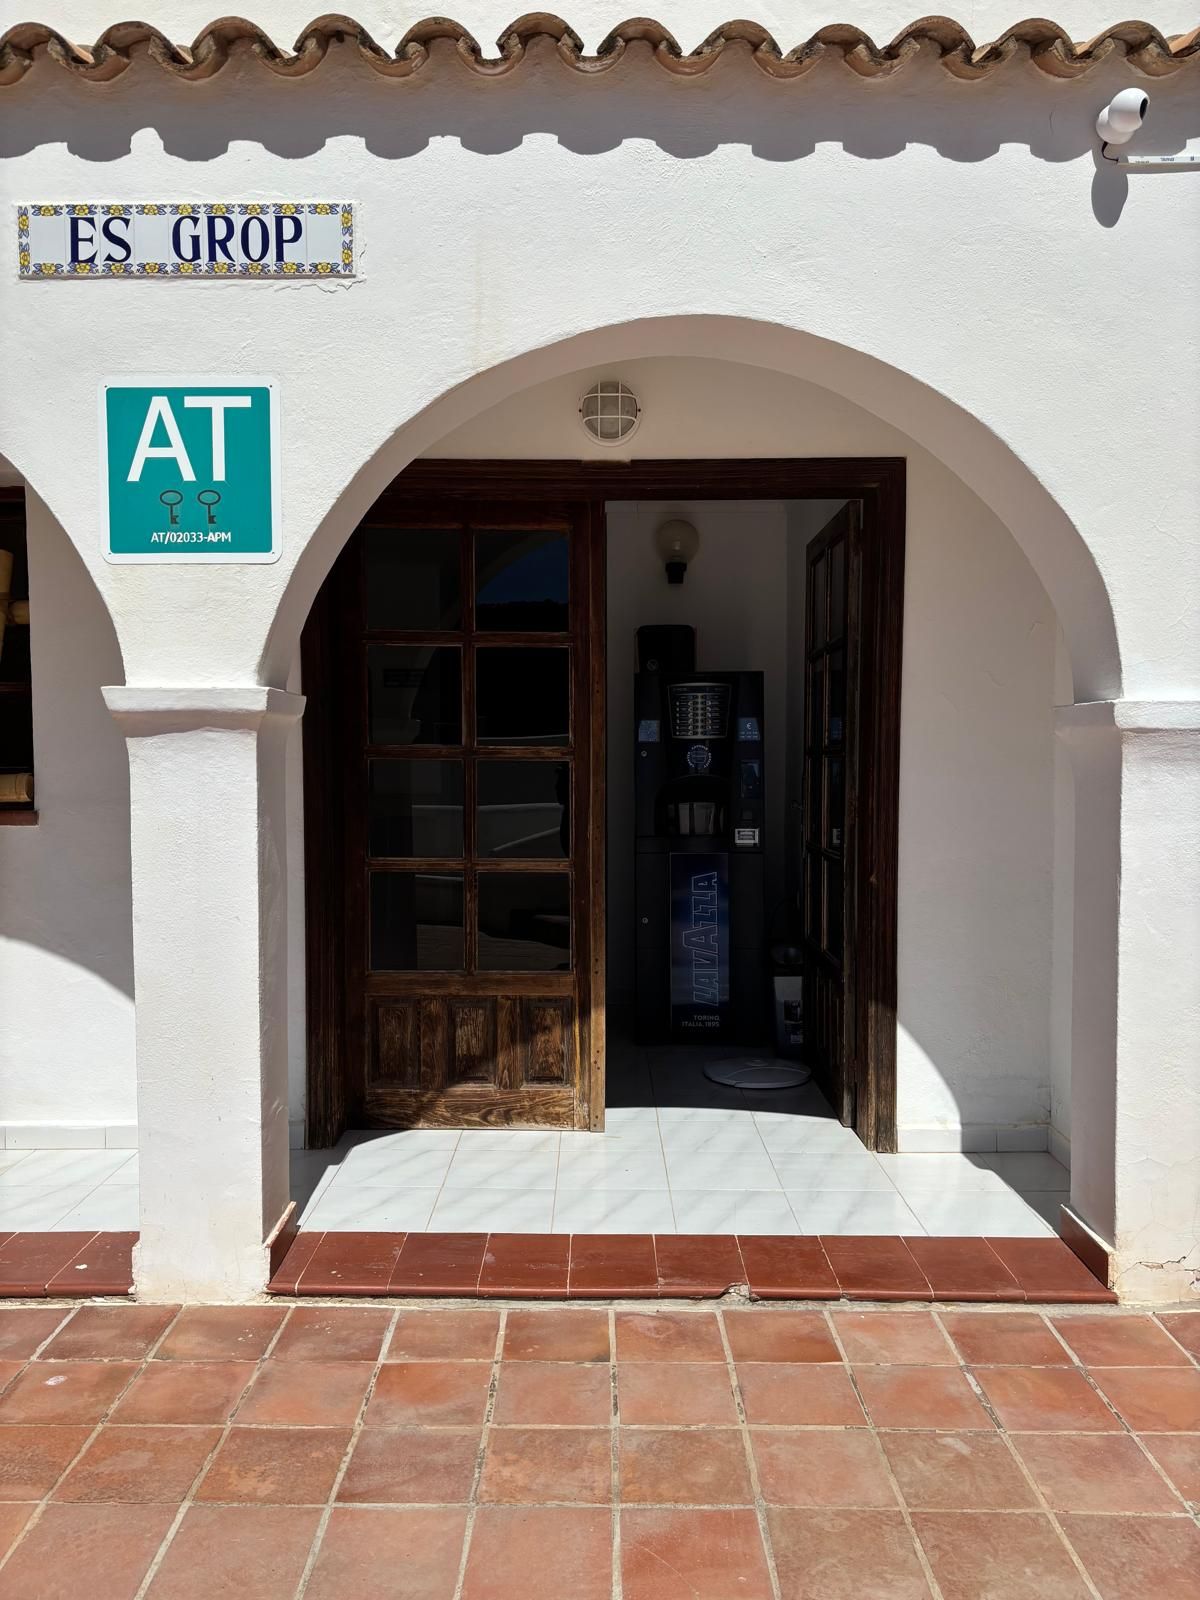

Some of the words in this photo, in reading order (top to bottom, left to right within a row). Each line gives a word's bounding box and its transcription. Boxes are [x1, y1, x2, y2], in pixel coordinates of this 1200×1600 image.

[69, 215, 132, 265] ES
[171, 214, 303, 264] GROP
[126, 395, 252, 482] AT
[150, 531, 232, 544] AT/02033-APM
[682, 871, 720, 1007] LAVAZZA
